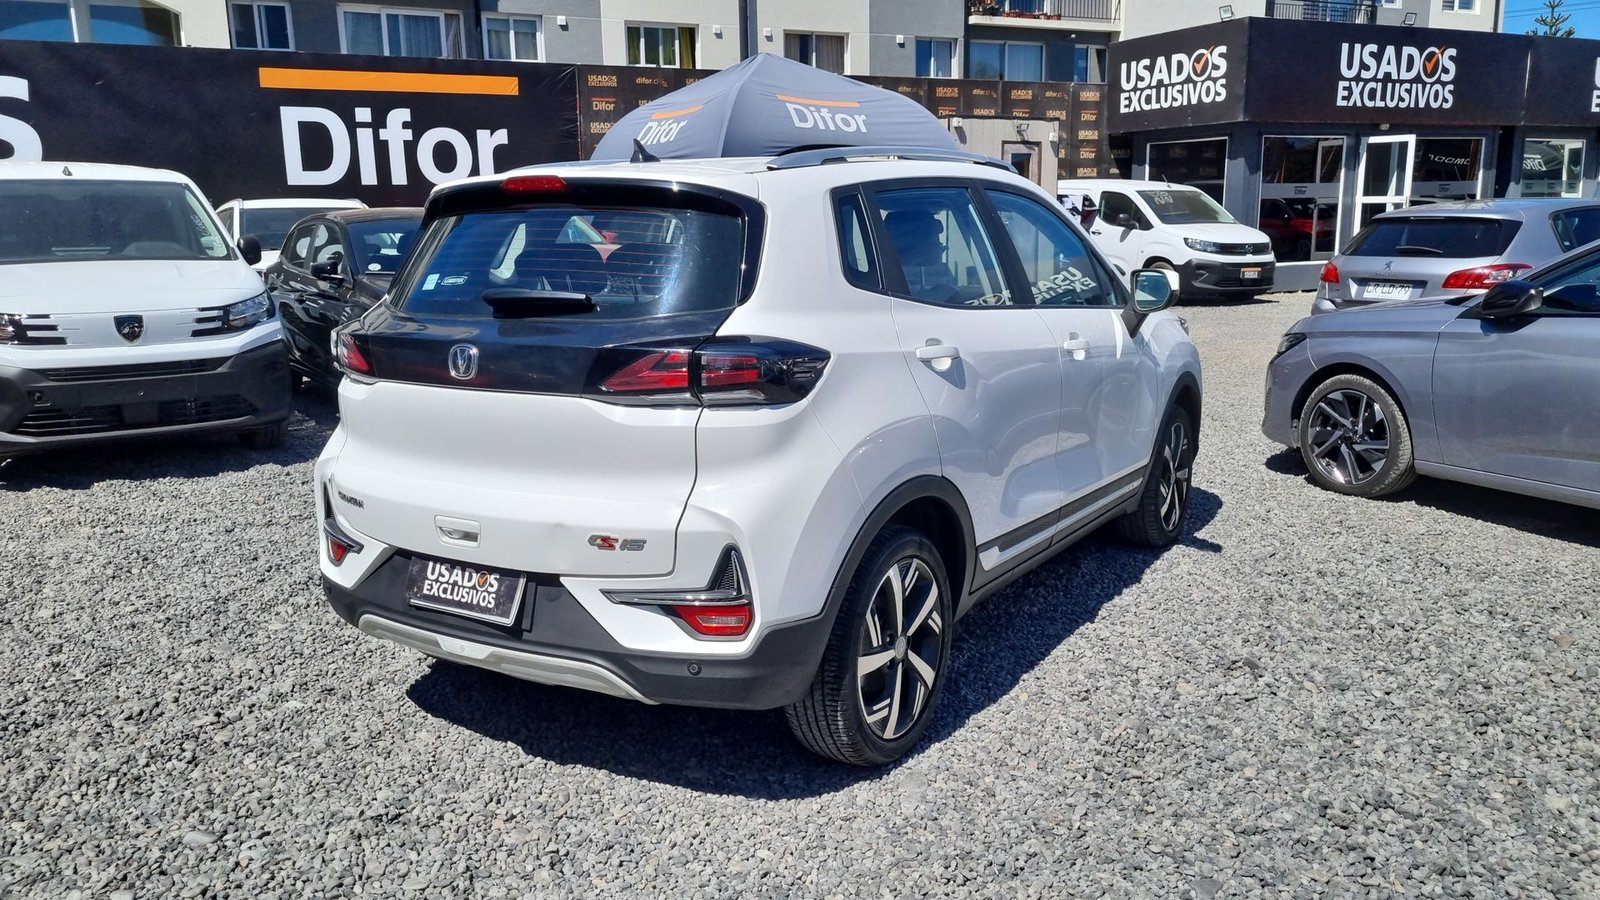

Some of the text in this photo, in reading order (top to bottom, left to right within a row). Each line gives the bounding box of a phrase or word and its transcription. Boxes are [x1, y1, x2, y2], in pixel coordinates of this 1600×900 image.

[1120, 45, 1228, 90] USADOS
[1340, 42, 1458, 83] USADOS
[592, 101, 616, 111] Difor
[1119, 78, 1227, 114] EXCLUSIVOS
[1336, 80, 1454, 109] EXCLUSIVOS
[637, 119, 689, 145] Difor
[784, 101, 868, 133] Difor
[1081, 113, 1097, 121] Difor
[280, 106, 509, 187] Difor
[1080, 151, 1096, 159] Difor
[427, 561, 500, 592] USADOS
[423, 581, 496, 609] EXCLUSIVOS
